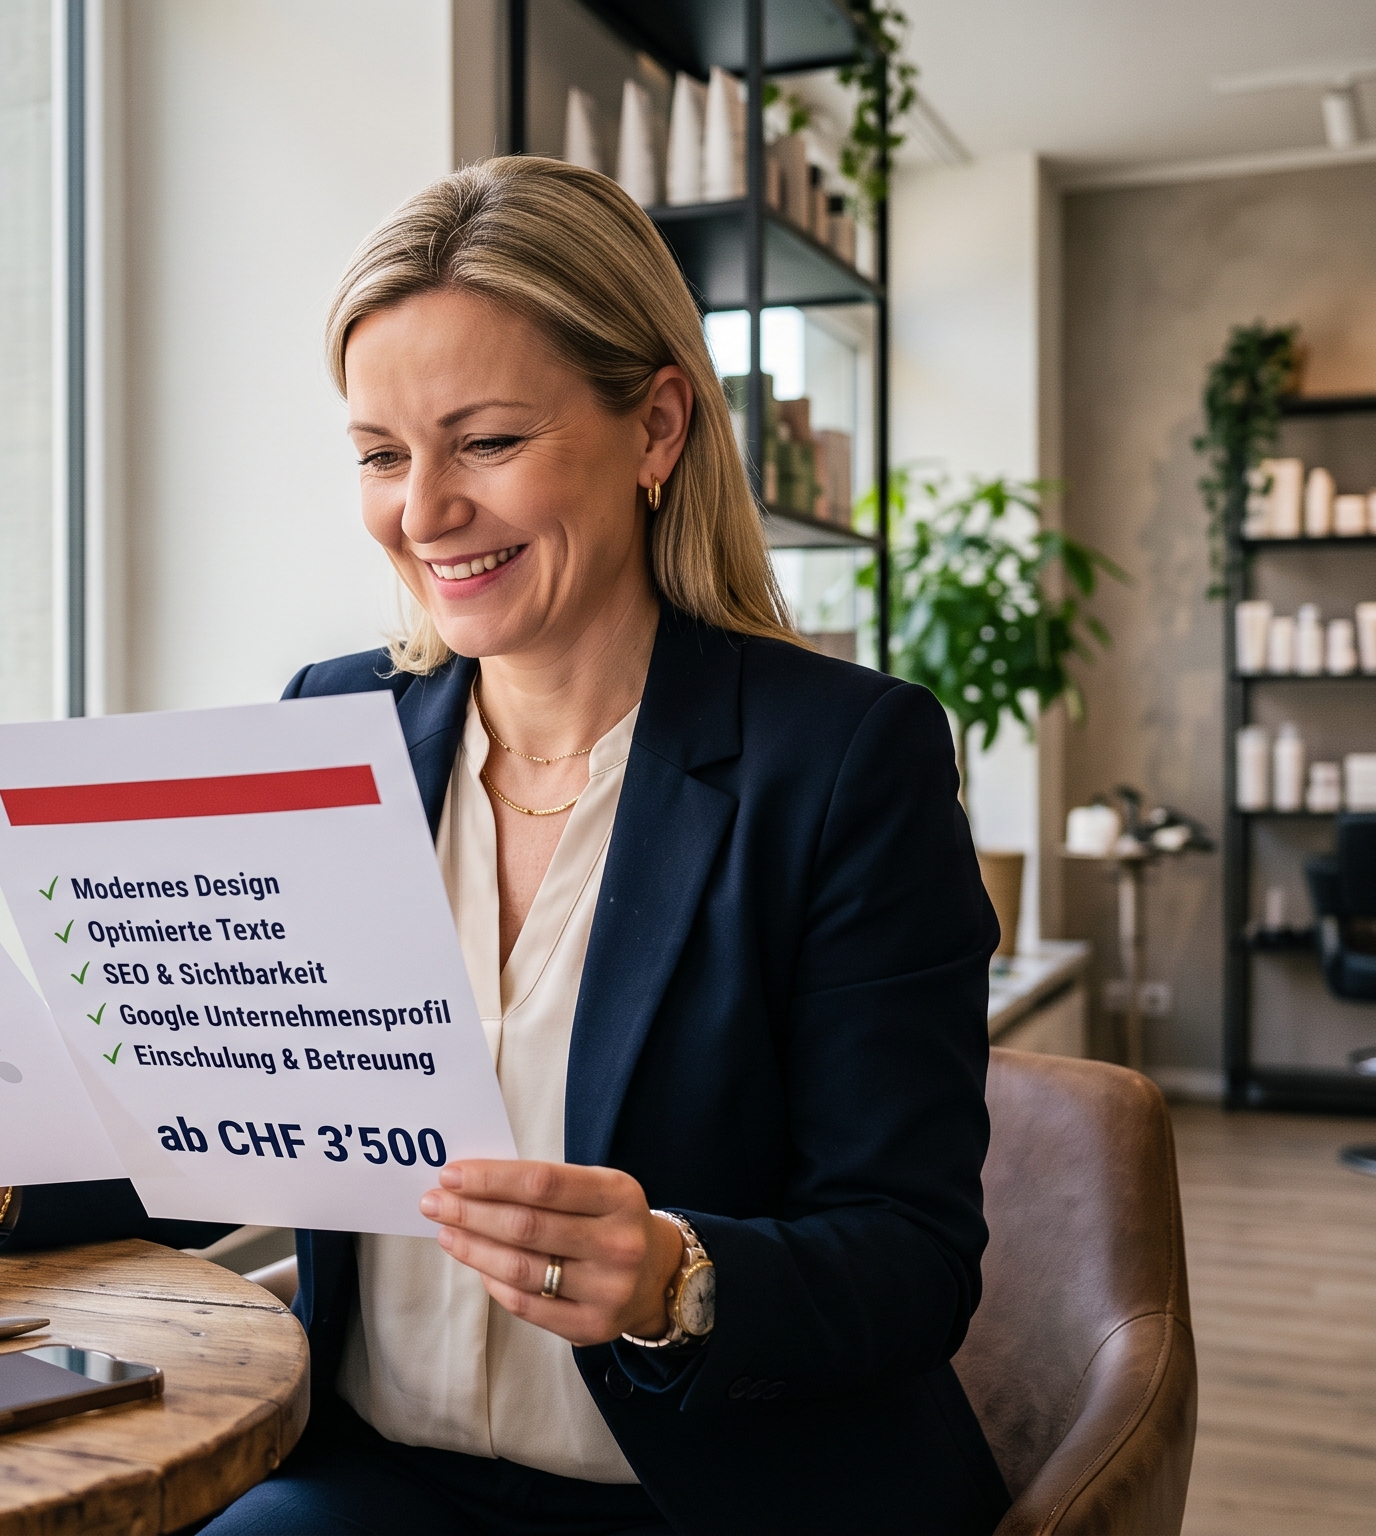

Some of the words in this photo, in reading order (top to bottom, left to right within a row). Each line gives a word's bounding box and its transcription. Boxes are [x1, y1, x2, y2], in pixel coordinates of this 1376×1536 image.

[71, 877, 188, 899] Modernes
[194, 872, 279, 900] Design
[88, 920, 212, 947] Optimierte
[216, 919, 285, 940] Texte
[103, 963, 149, 984] SEO
[157, 964, 174, 984] &
[179, 961, 327, 984] Sichtbarkeit
[120, 1005, 199, 1031] Google
[204, 1000, 451, 1031] Unternehmensprofil
[134, 1045, 276, 1074] Einschulung
[282, 1048, 300, 1069] &
[305, 1049, 435, 1075] Betreuung
[158, 1116, 208, 1152] ab
[218, 1121, 305, 1158] CHF
